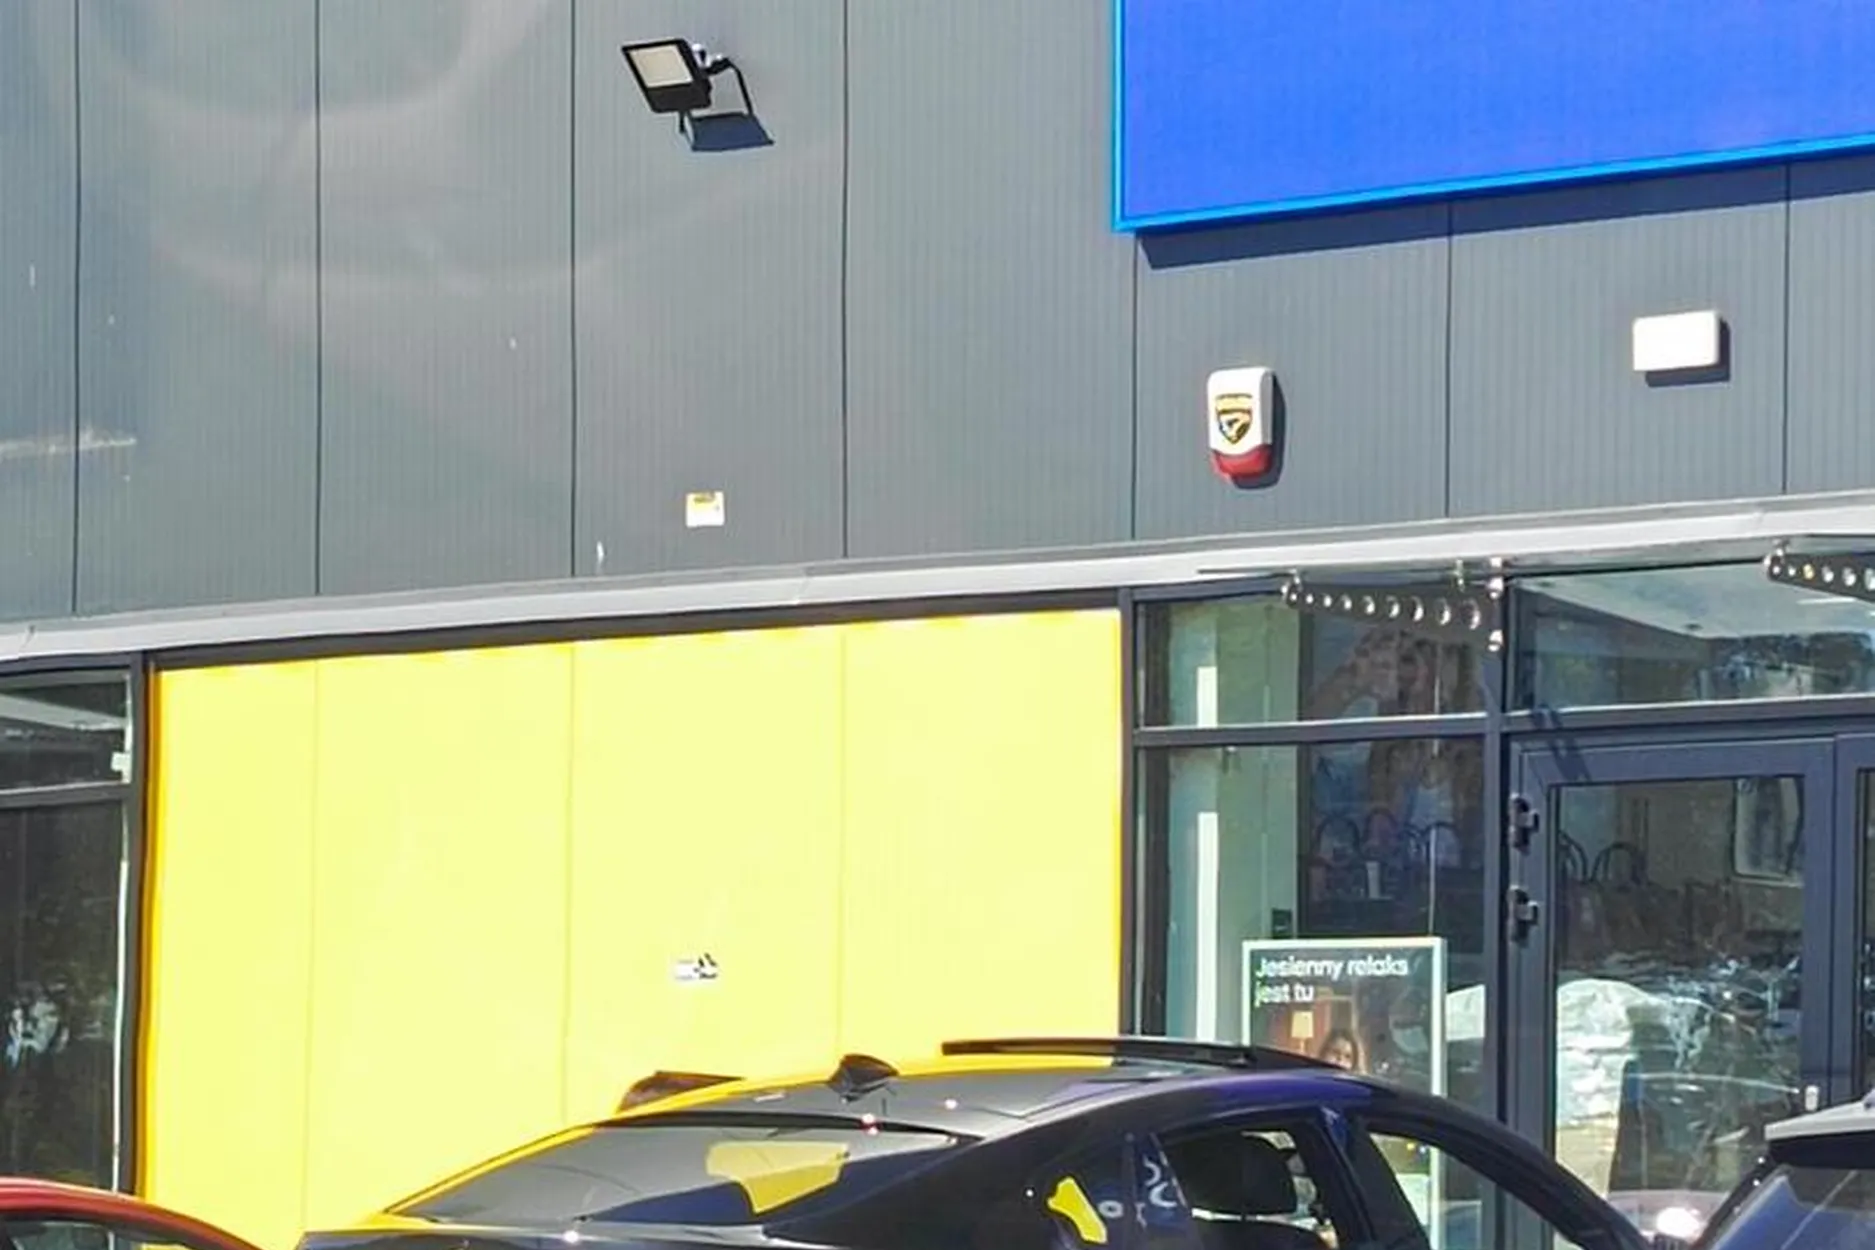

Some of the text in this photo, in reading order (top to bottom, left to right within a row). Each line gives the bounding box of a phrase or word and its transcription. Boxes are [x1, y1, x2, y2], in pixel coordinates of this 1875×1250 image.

[1256, 954, 1409, 980] Jesienny relaks
[1254, 983, 1315, 1007] jest tu
